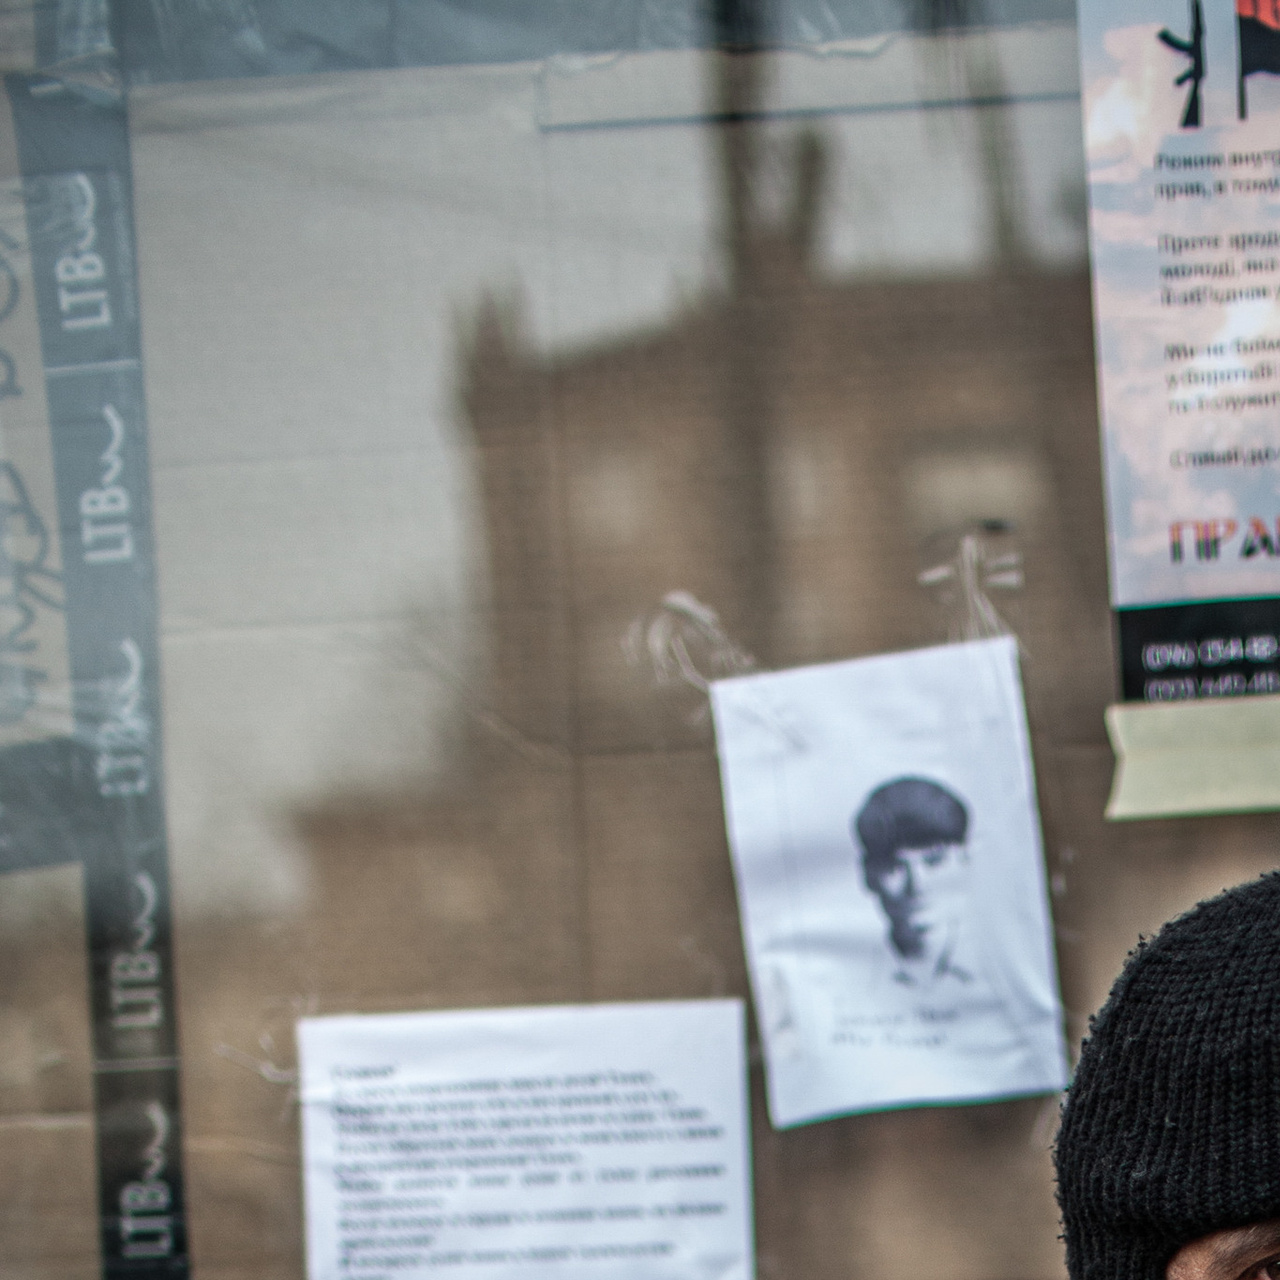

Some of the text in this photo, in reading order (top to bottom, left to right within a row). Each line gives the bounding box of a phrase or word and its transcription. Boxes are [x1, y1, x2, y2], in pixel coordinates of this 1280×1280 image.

[1154, 151, 1224, 172] Режим
[1160, 233, 1222, 256] Проте
[79, 484, 134, 564] LTB
[110, 951, 164, 1030] LTB
[119, 1177, 173, 1260] LTB
